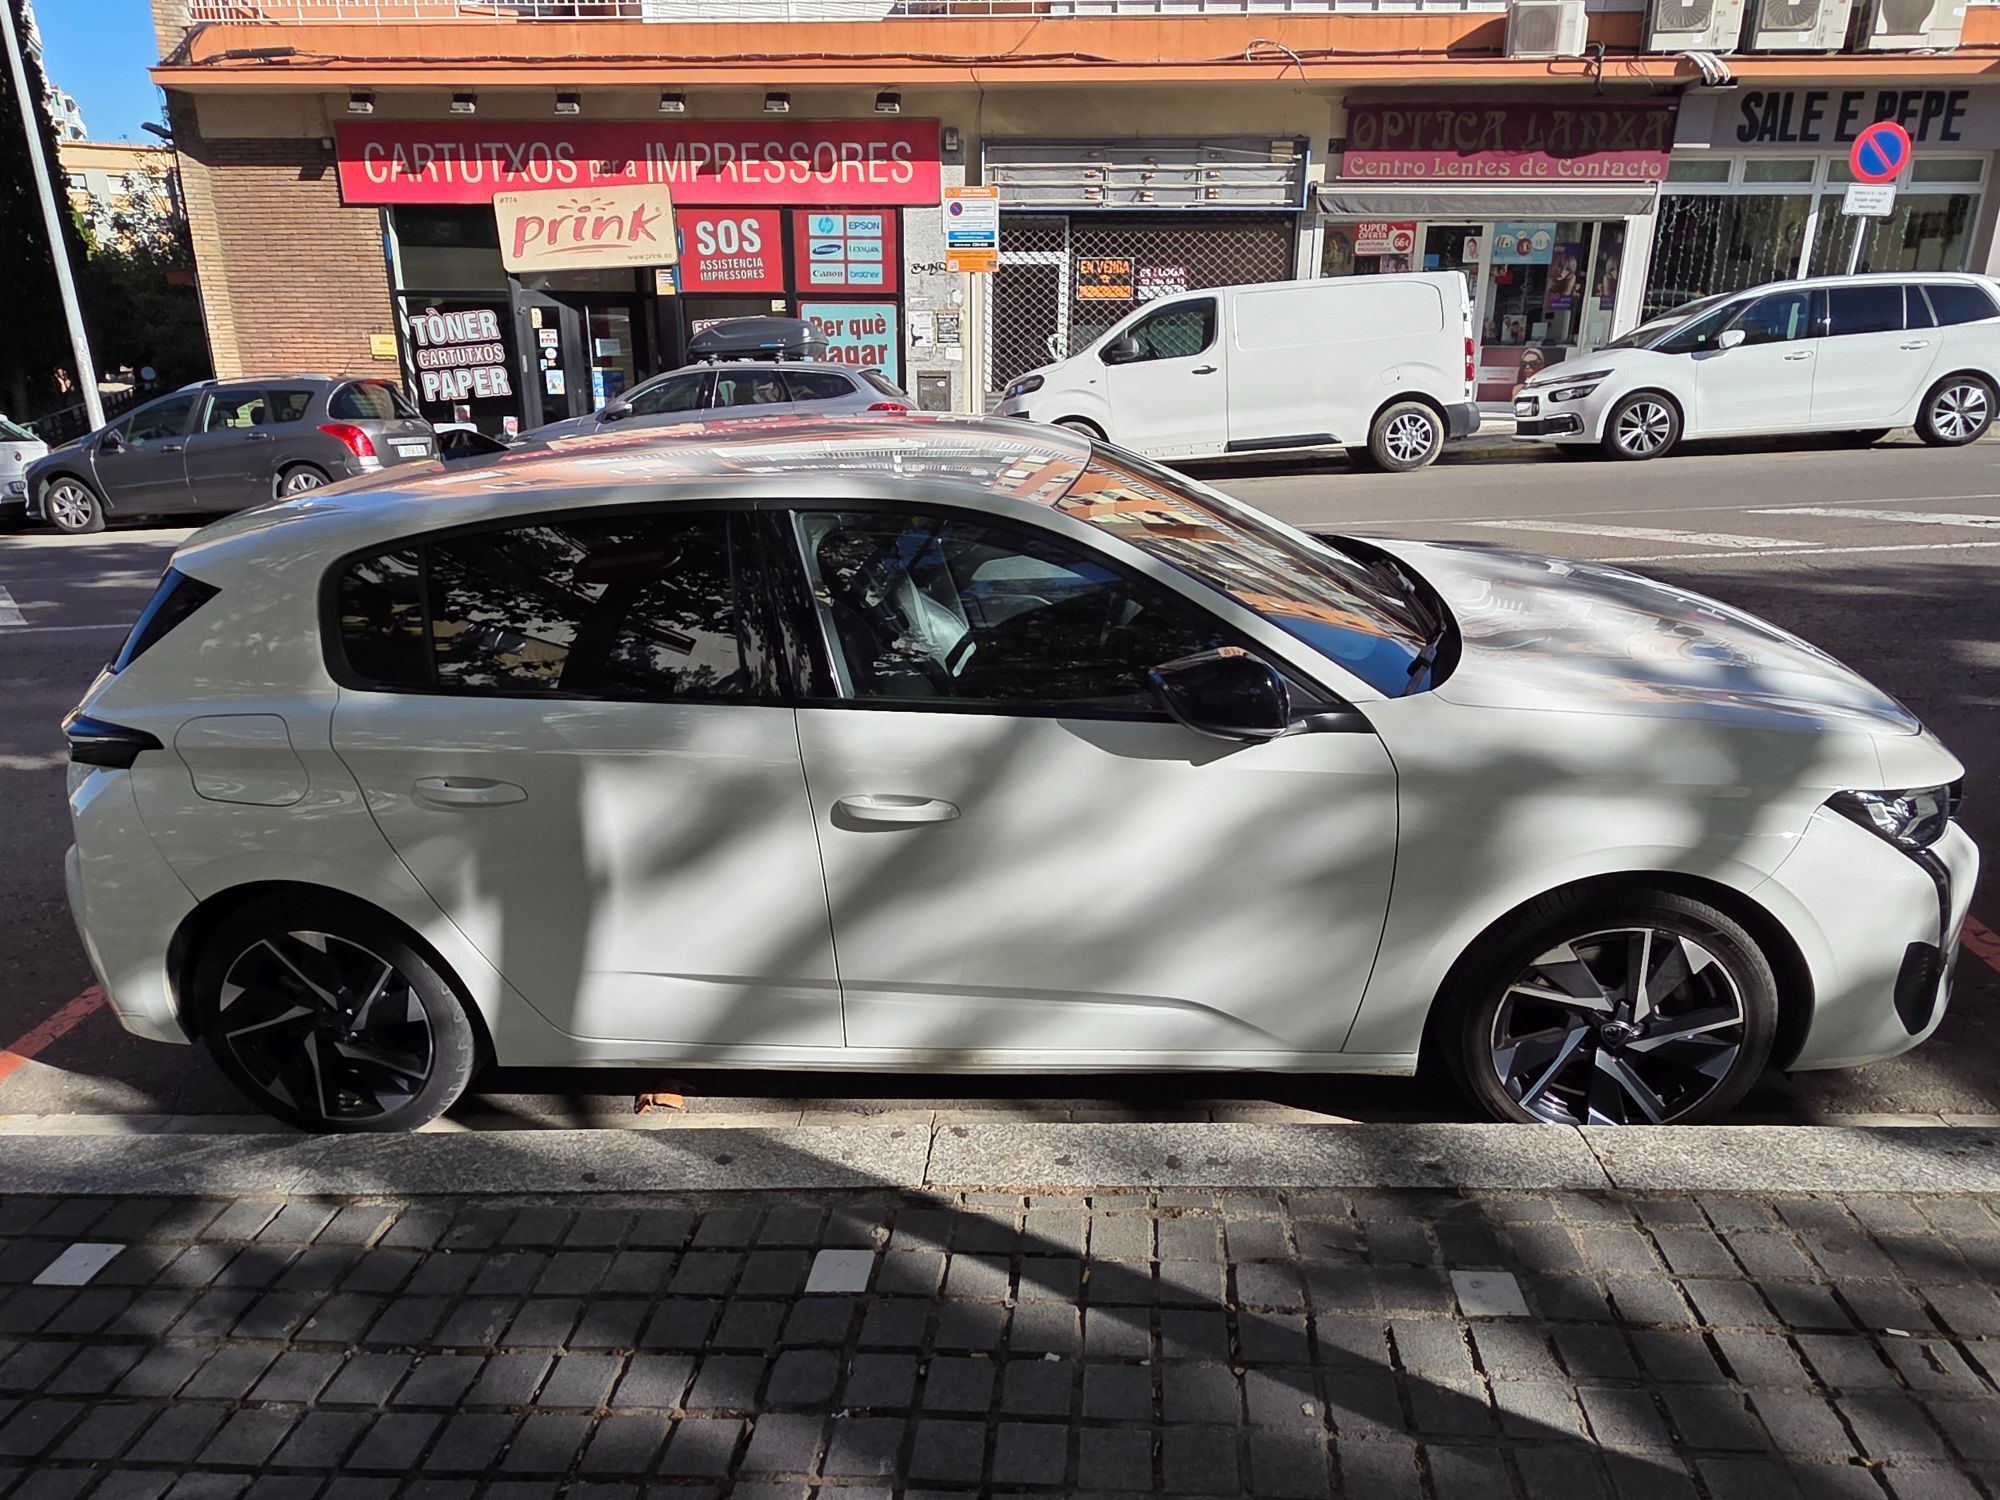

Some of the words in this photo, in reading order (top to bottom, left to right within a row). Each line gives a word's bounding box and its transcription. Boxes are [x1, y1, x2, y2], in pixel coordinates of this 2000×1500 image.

[1737, 91, 1828, 143] SALE
[1834, 91, 1865, 142] E
[1872, 90, 1970, 142] PEPE
[1352, 111, 1507, 149] OPTICA
[364, 142, 577, 183] CARTUTXOS
[588, 159, 618, 181] per
[625, 160, 637, 178] a
[646, 141, 913, 183] IMPRESSORES
[1350, 157, 1426, 176] Centro
[1432, 157, 1511, 176] Lentes
[1520, 158, 1547, 176] de
[1557, 159, 1662, 177] Contacto
[513, 202, 663, 259] prink
[696, 218, 762, 256] SOS
[848, 221, 880, 231] EPSON
[1358, 231, 1388, 240] OFERTA
[1359, 223, 1388, 233] SUPER
[700, 257, 764, 271] ASSISTENCIA
[700, 269, 765, 282] IMPRESSORES
[812, 269, 843, 278] Canon
[849, 270, 880, 279] brother
[1081, 260, 1094, 274] EN
[1096, 260, 1130, 274] VENDA
[410, 308, 501, 346] TÒNER
[849, 312, 887, 341] què
[417, 343, 505, 369] CARTUTXOS
[812, 343, 888, 366] agar
[421, 365, 512, 402] PAPER
